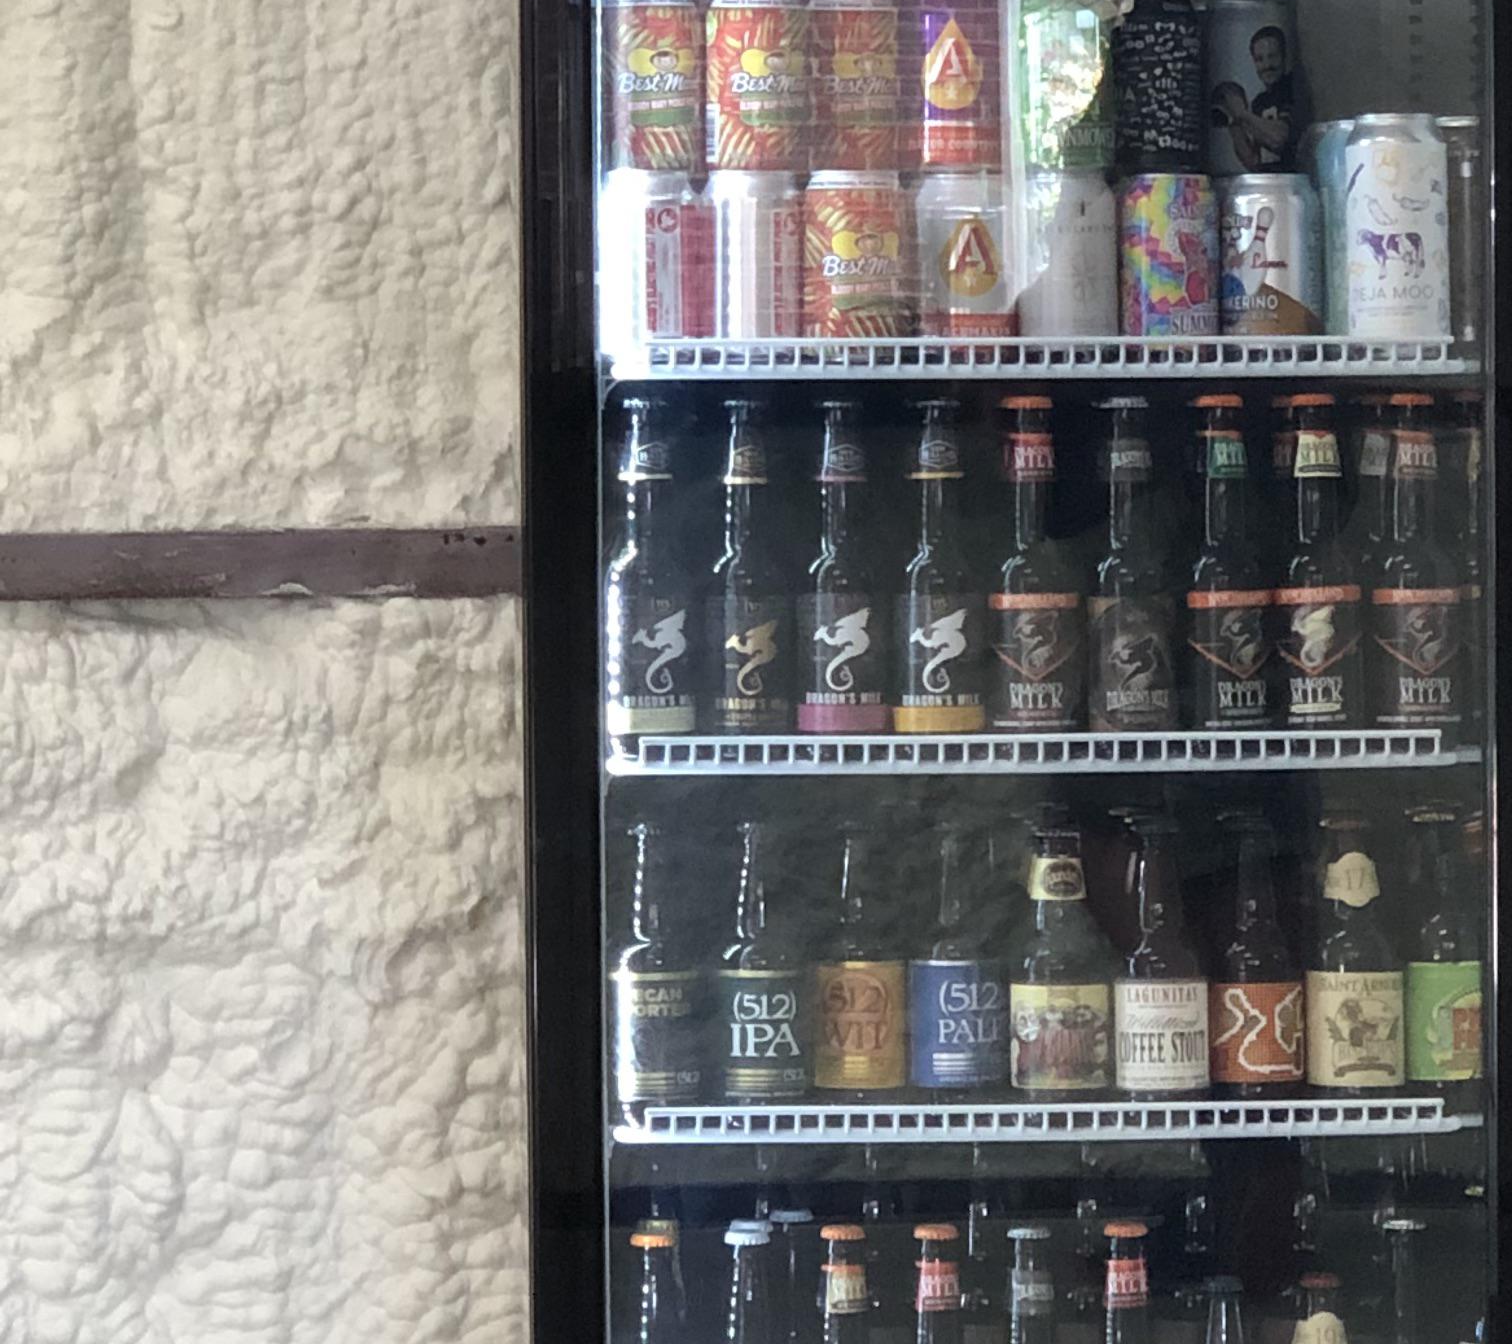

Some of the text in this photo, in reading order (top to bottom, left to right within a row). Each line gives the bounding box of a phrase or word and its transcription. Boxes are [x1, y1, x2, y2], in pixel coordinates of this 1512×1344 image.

[1010, 691, 1064, 709] MILK
[1219, 690, 1267, 708] MILK
[1291, 686, 1343, 703] MILK
[1400, 687, 1452, 704] MILK
[631, 988, 683, 1003] ECAN
[1127, 986, 1198, 1003] LAGUNITAS
[633, 1003, 691, 1017] ORTE
[733, 991, 796, 1023] (512)
[730, 1022, 801, 1058] IPA
[1120, 1029, 1206, 1064] COFFEE STOUT
